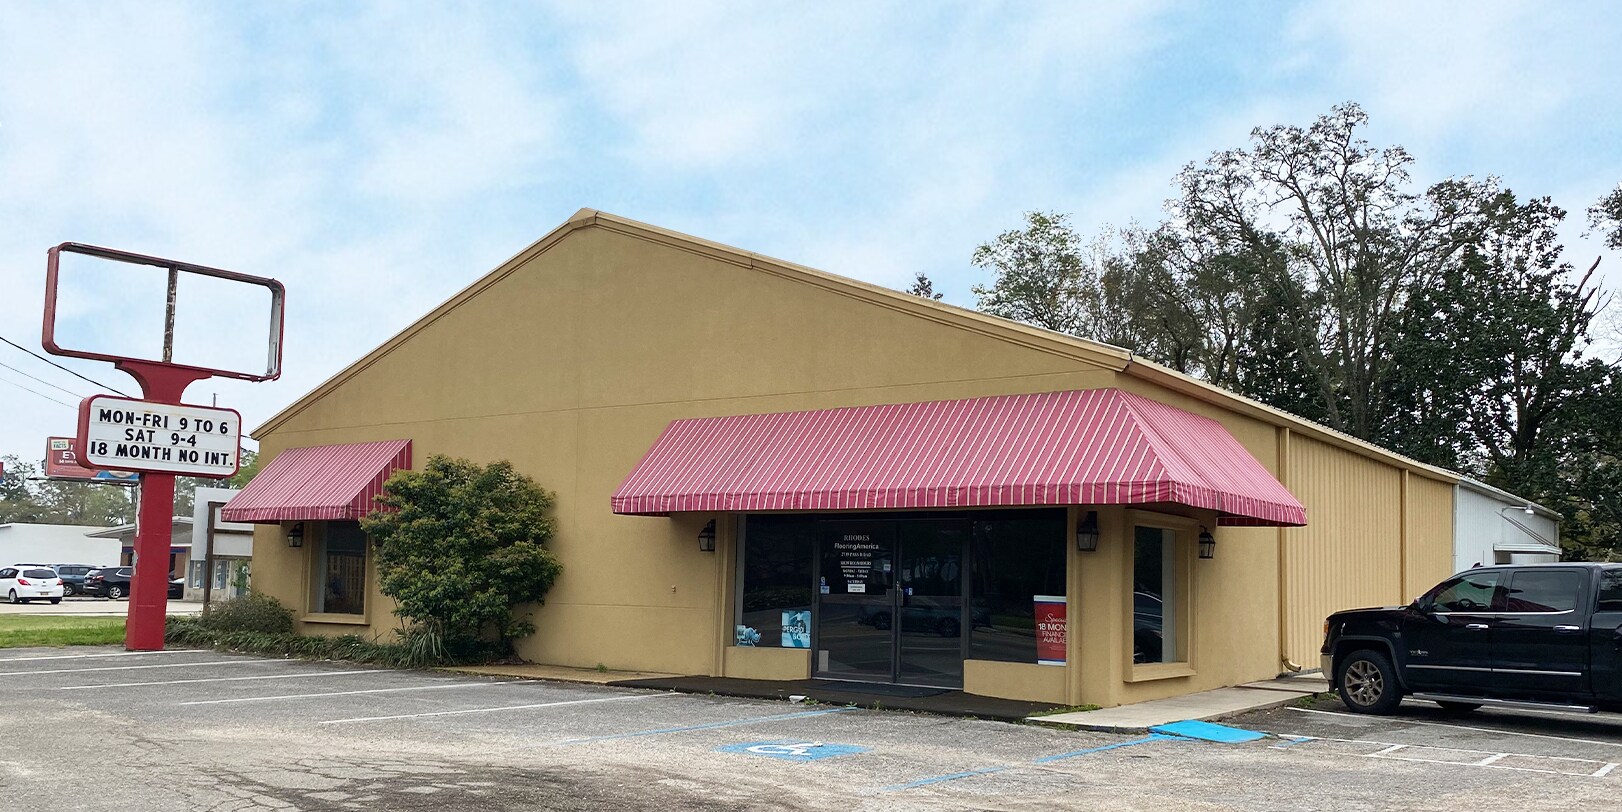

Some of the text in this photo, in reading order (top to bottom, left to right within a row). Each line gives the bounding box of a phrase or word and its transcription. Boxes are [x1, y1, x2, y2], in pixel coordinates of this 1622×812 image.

[99, 409, 228, 434] MON-FRI 9 TO 6
[125, 429, 196, 447] SAT 9-4
[91, 442, 233, 466] 18 MONTH NO INT.
[834, 542, 879, 550] FlooringAmerica
